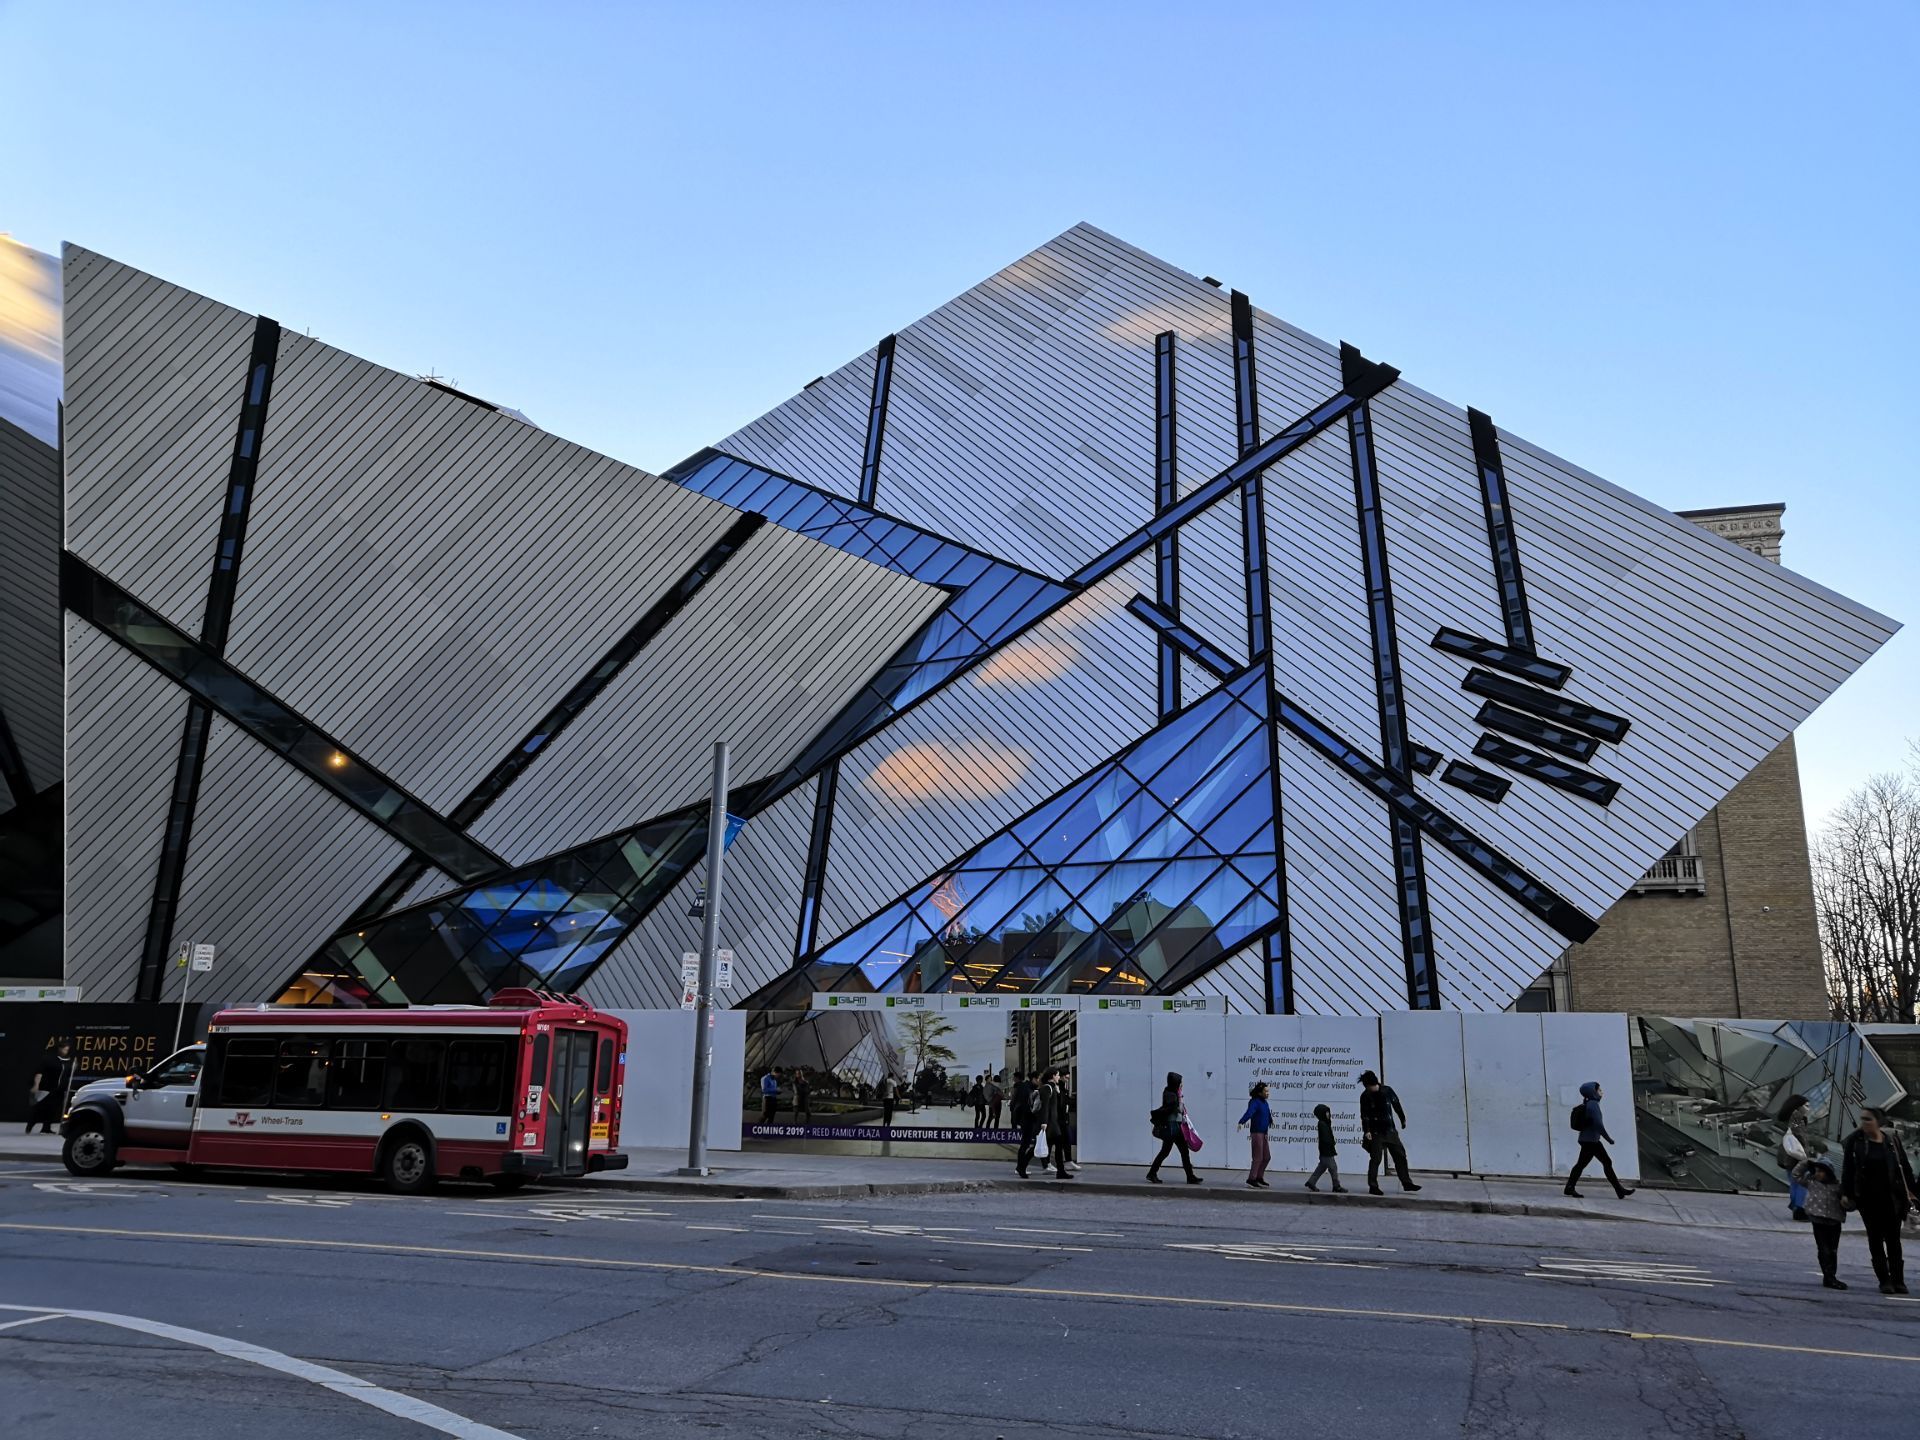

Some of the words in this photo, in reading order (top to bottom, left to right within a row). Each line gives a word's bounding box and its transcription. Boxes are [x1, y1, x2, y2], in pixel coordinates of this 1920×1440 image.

[838, 996, 867, 1004] GILLAM
[895, 997, 925, 1005] GILLAM
[969, 997, 999, 1005] GILLAM
[1030, 998, 1061, 1006] GILLAM
[1109, 999, 1141, 1007] GILLAM
[1173, 999, 1207, 1008] GILLAM
[45, 1036, 69, 1050] A
[75, 1036, 127, 1051] TEMPS
[134, 1036, 157, 1052] DE
[1250, 1043, 1271, 1052] Please
[1311, 1046, 1351, 1054] appearance
[80, 1056, 154, 1071] BRANDT
[1238, 1056, 1256, 1064] while
[1298, 1056, 1310, 1065] the
[1312, 1057, 1364, 1067] transformation
[1252, 1067, 1261, 1077] of
[1261, 1068, 1273, 1076] this
[1292, 1069, 1300, 1077] to
[1324, 1069, 1349, 1078] vibrant
[1304, 1080, 1315, 1090] for
[1331, 1082, 1356, 1090] visitors
[261, 1116, 303, 1126] Wheel-Trans
[1331, 1112, 1356, 1120] endant
[752, 1126, 784, 1135] COMING
[786, 1126, 805, 1136] 2019
[812, 1127, 830, 1137] REED
[831, 1128, 856, 1138] FAMILY
[858, 1128, 881, 1138] PLAZA
[1299, 1124, 1319, 1133] espac
[890, 1129, 938, 1139] OUVERTURE
[940, 1130, 952, 1140] EN
[954, 1130, 974, 1140] 2019
[981, 1131, 1006, 1141] PLACE
